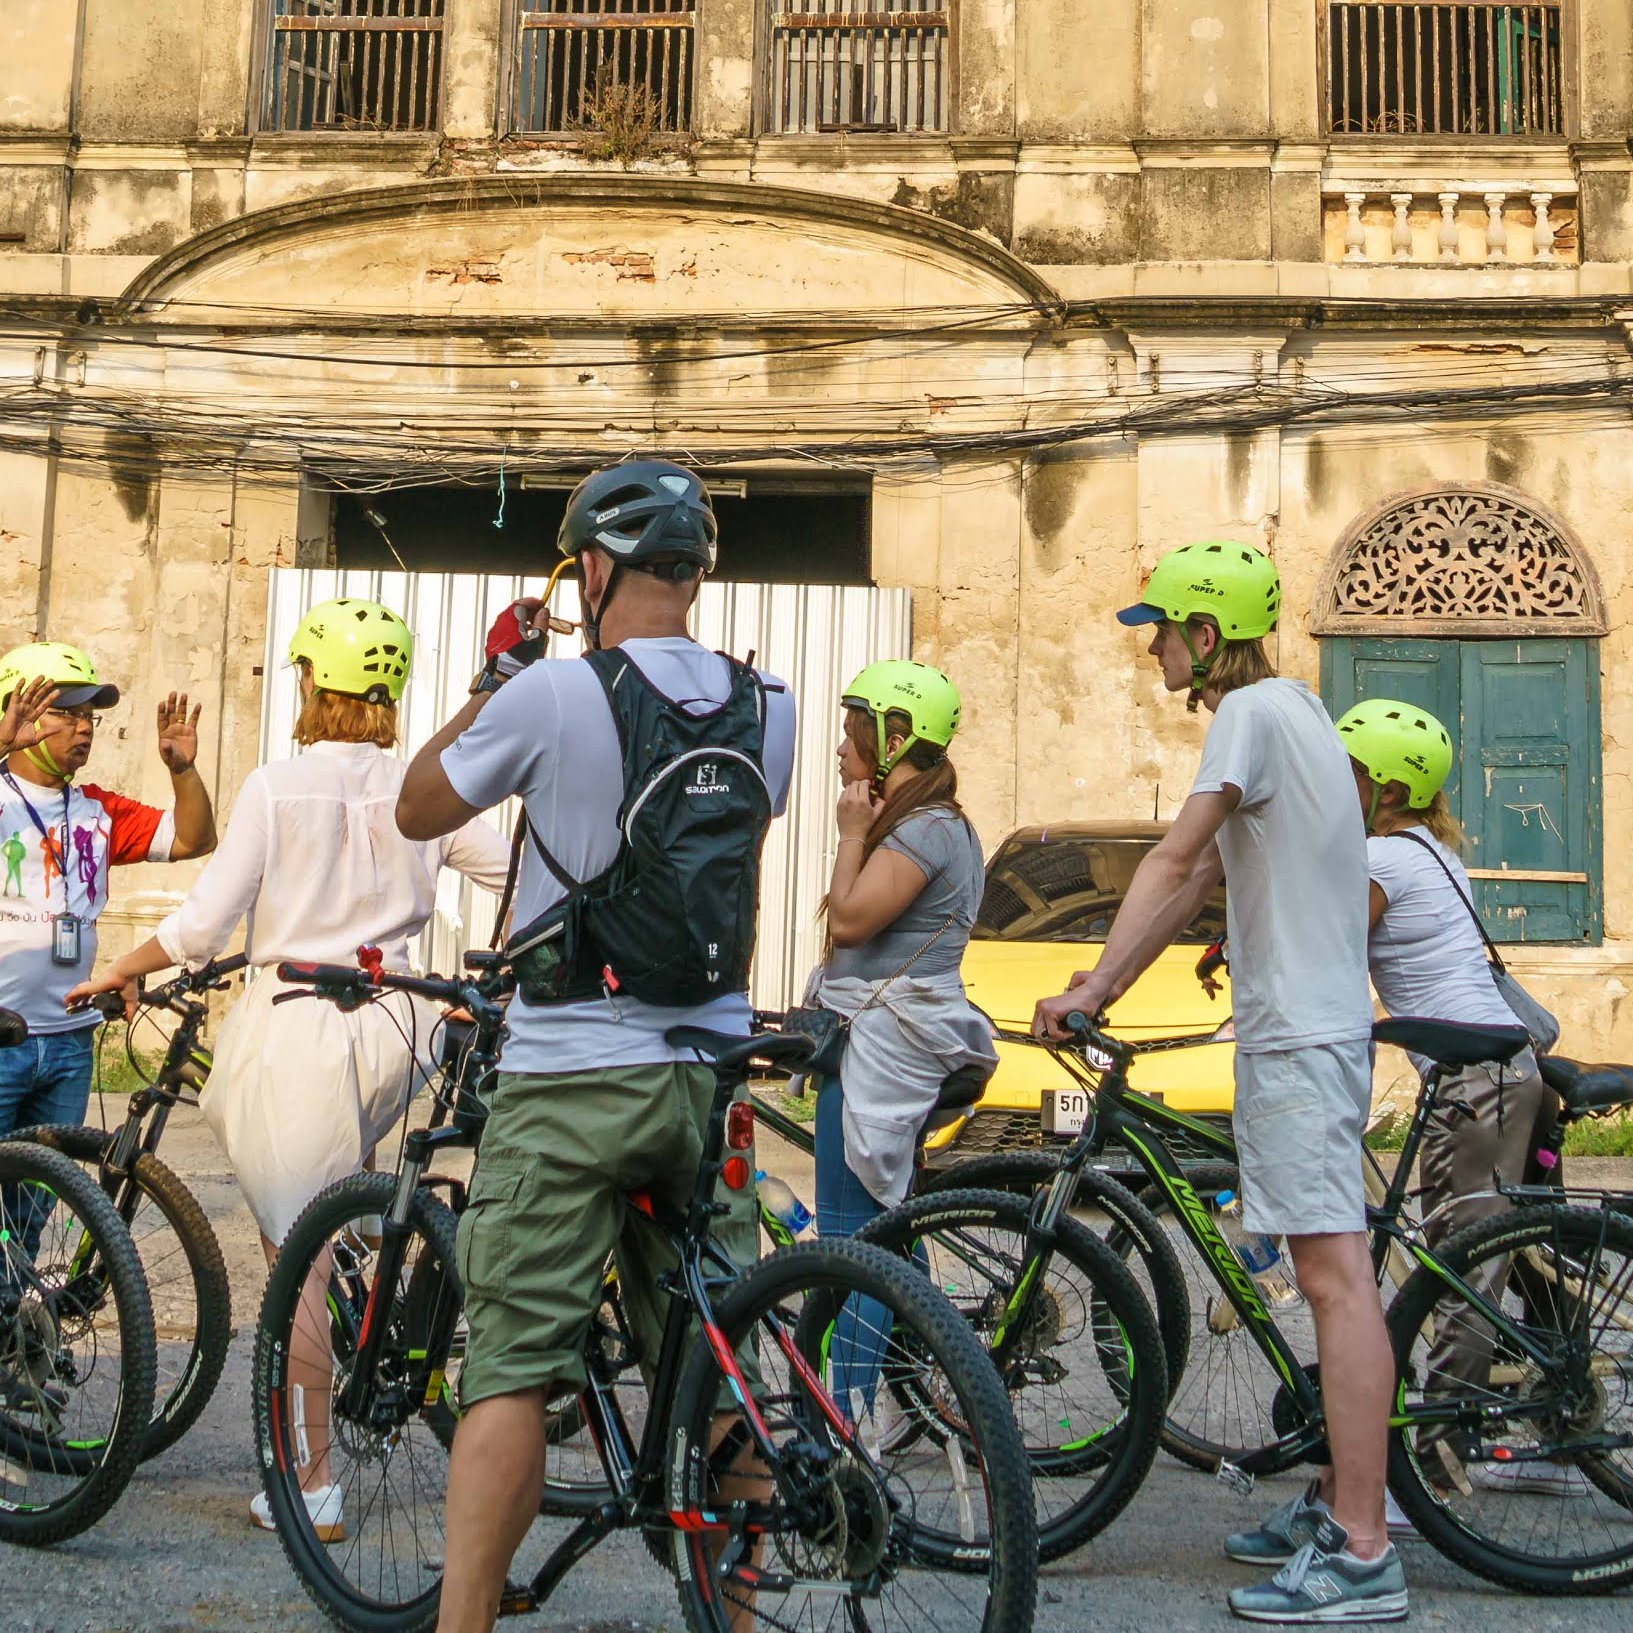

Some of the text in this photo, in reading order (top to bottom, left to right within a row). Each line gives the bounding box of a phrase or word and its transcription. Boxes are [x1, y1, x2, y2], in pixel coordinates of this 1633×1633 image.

[708, 943, 718, 955] 12
[911, 1209, 997, 1229] MERIDA
[1169, 1176, 1273, 1323] MERIDA
